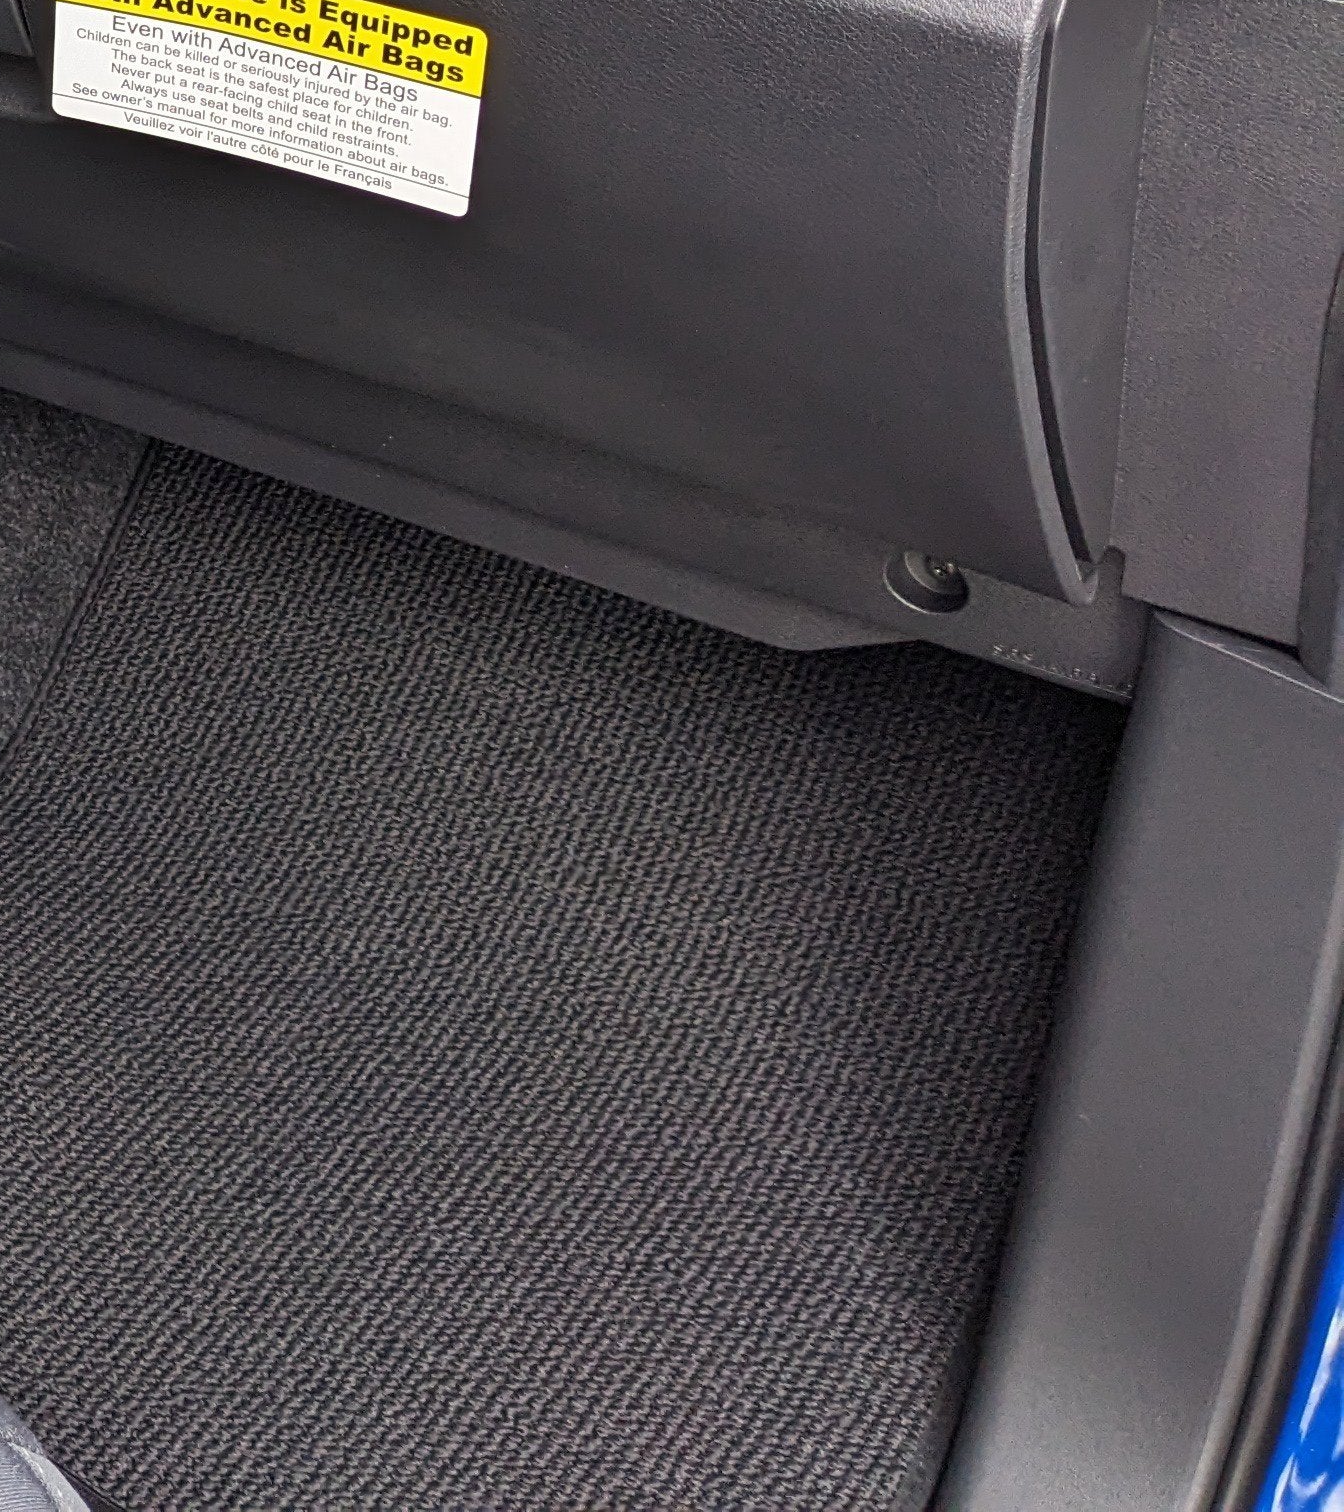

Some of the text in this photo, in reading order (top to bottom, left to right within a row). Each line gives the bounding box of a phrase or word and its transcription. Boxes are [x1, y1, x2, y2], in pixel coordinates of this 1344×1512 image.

[112, 15, 419, 102] Even with Advanced Air Bags
[319, 0, 474, 57] Equipped
[322, 30, 372, 58] Air
[382, 43, 464, 83] Bags
[76, 27, 453, 128] Children can be killed or seriously injured by the air bag.
[111, 48, 414, 132] The back seat is the safest place for children.
[111, 63, 412, 146] Never put a rear-facing child seat in the front.
[121, 78, 399, 158] Always use seat belts and child restraints.
[72, 82, 449, 187] See owner's manual for more information about air bags.
[124, 111, 393, 190] Veuillez voir l'autre côté pour le Français
